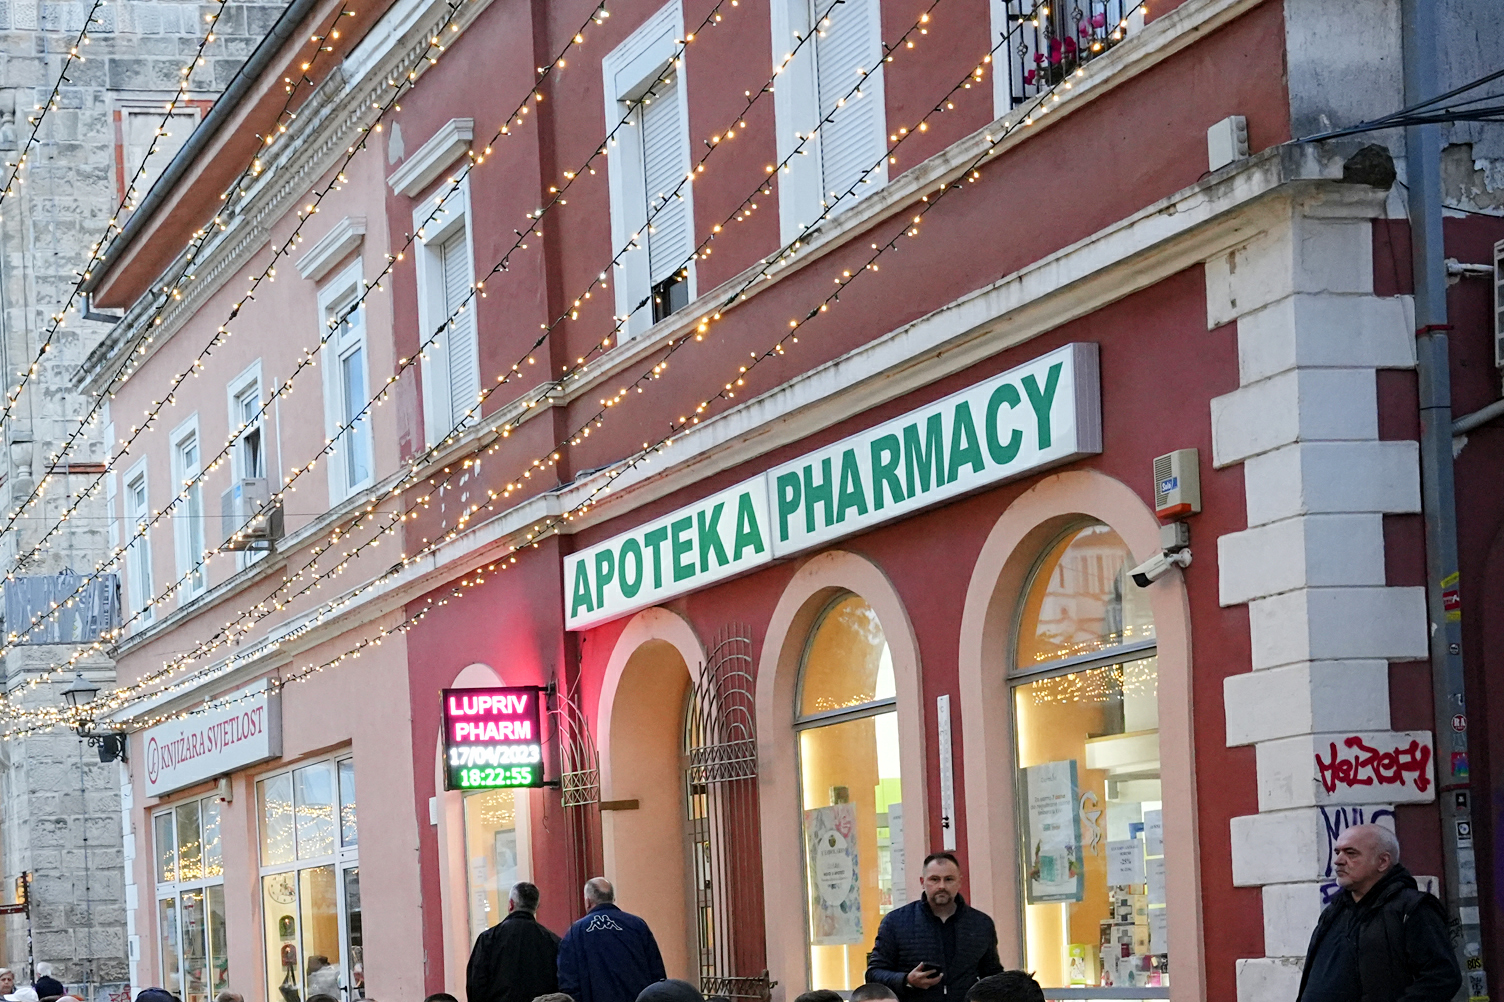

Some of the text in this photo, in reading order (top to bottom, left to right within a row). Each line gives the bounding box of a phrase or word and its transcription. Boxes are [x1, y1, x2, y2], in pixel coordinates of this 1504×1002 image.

[570, 361, 1064, 619] APOTEKA PHARMACY
[449, 695, 527, 716] LUPRIV
[160, 730, 206, 771] KNJIŽARA
[207, 705, 264, 755] SVJETLOST
[455, 721, 532, 742] PHARM
[449, 745, 540, 768] 17/04/2023
[460, 766, 533, 787] 18:22:55
